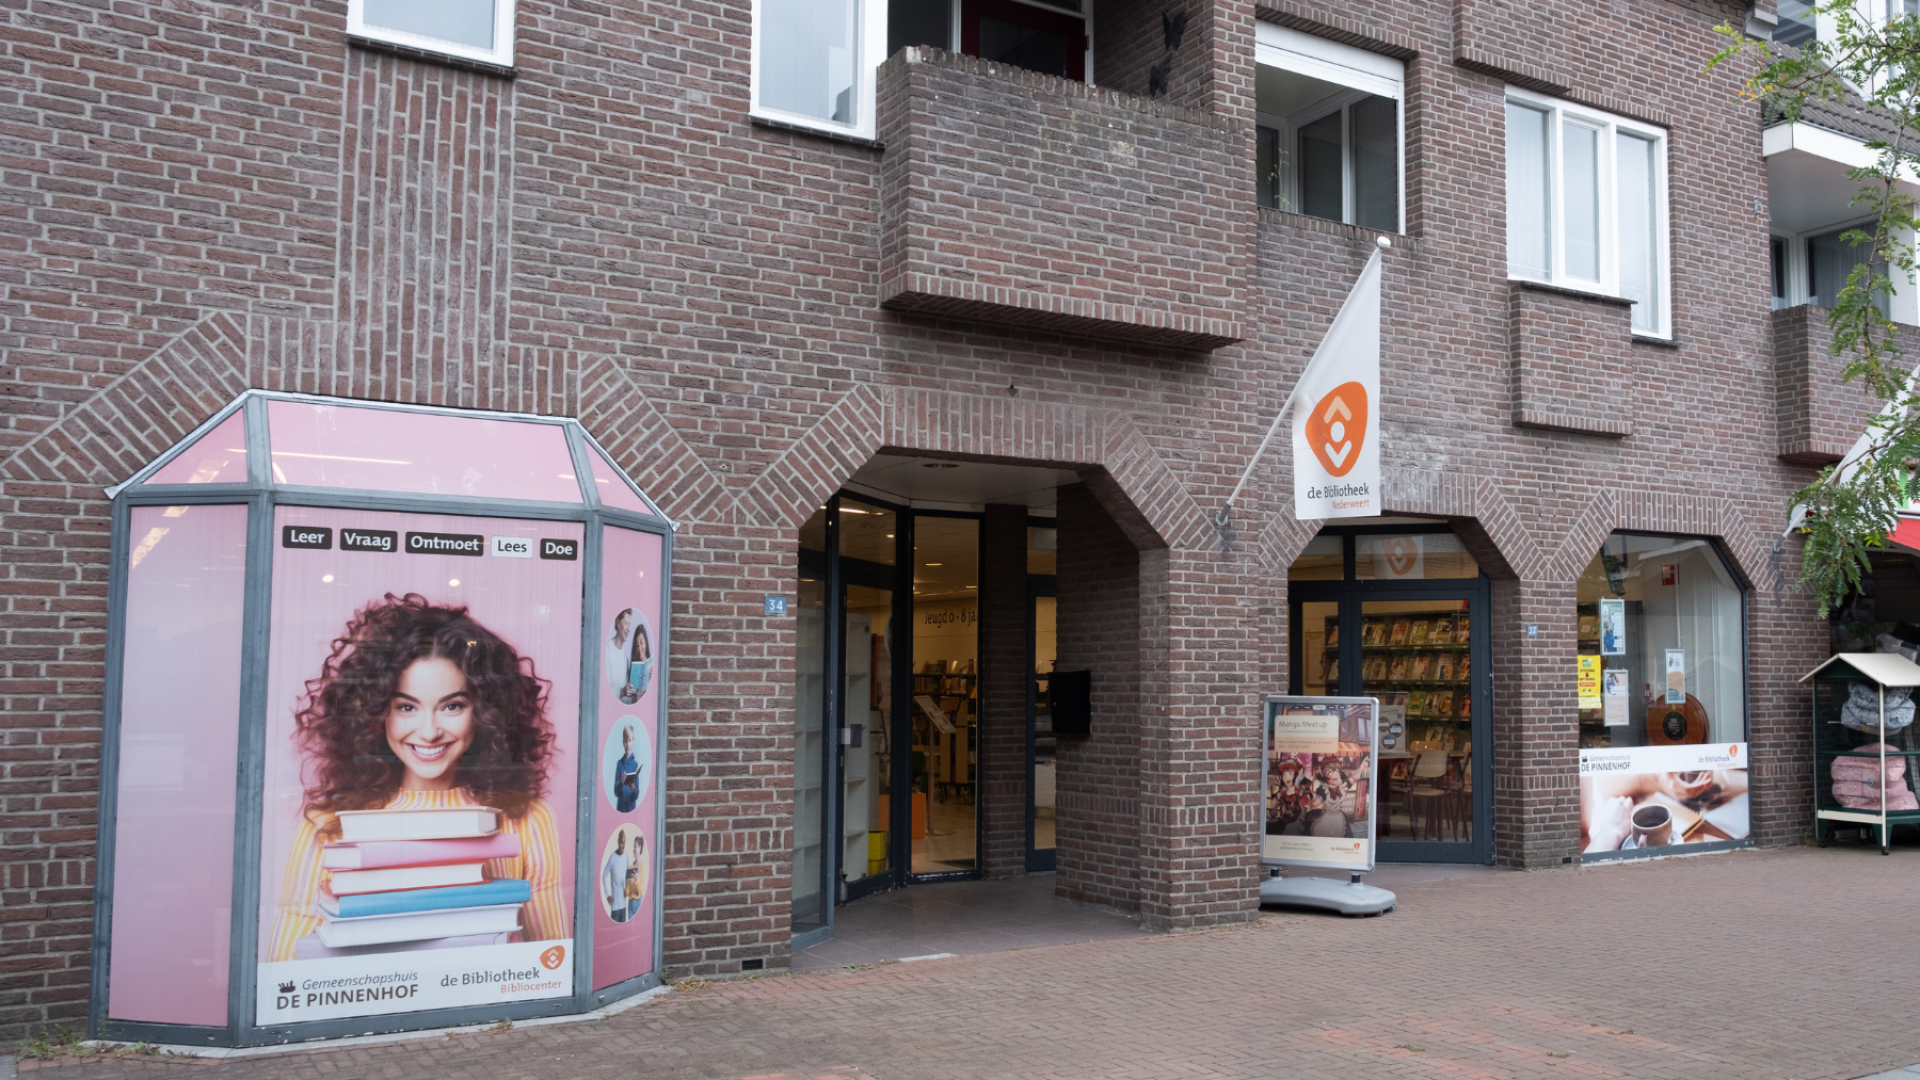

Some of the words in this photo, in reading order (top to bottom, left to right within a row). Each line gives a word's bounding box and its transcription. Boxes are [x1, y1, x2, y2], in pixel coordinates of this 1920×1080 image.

[1307, 487, 1322, 499] de
[1324, 483, 1370, 498] Bibliotheek
[1332, 499, 1370, 509] Nederweert
[290, 529, 325, 544] Leer
[344, 532, 392, 550] Vraag
[410, 535, 479, 551] Ontmoet
[497, 540, 528, 553] Lees
[545, 542, 573, 555] Doe
[768, 598, 783, 611] 34
[924, 609, 947, 628] Jeugd
[961, 608, 966, 623] 8
[967, 608, 977, 627] ja
[1278, 721, 1301, 729] Manga
[1302, 721, 1328, 729] Meetup
[1581, 763, 1590, 771] DE
[1591, 761, 1631, 771] PINNENHOF
[302, 970, 419, 991] Gemeenschapshuis
[440, 974, 459, 987] de
[462, 966, 540, 986] Bibliotheek
[500, 980, 562, 993] Bibliocenter
[276, 995, 301, 1010] DE
[306, 984, 419, 1007] PINNENHOF
